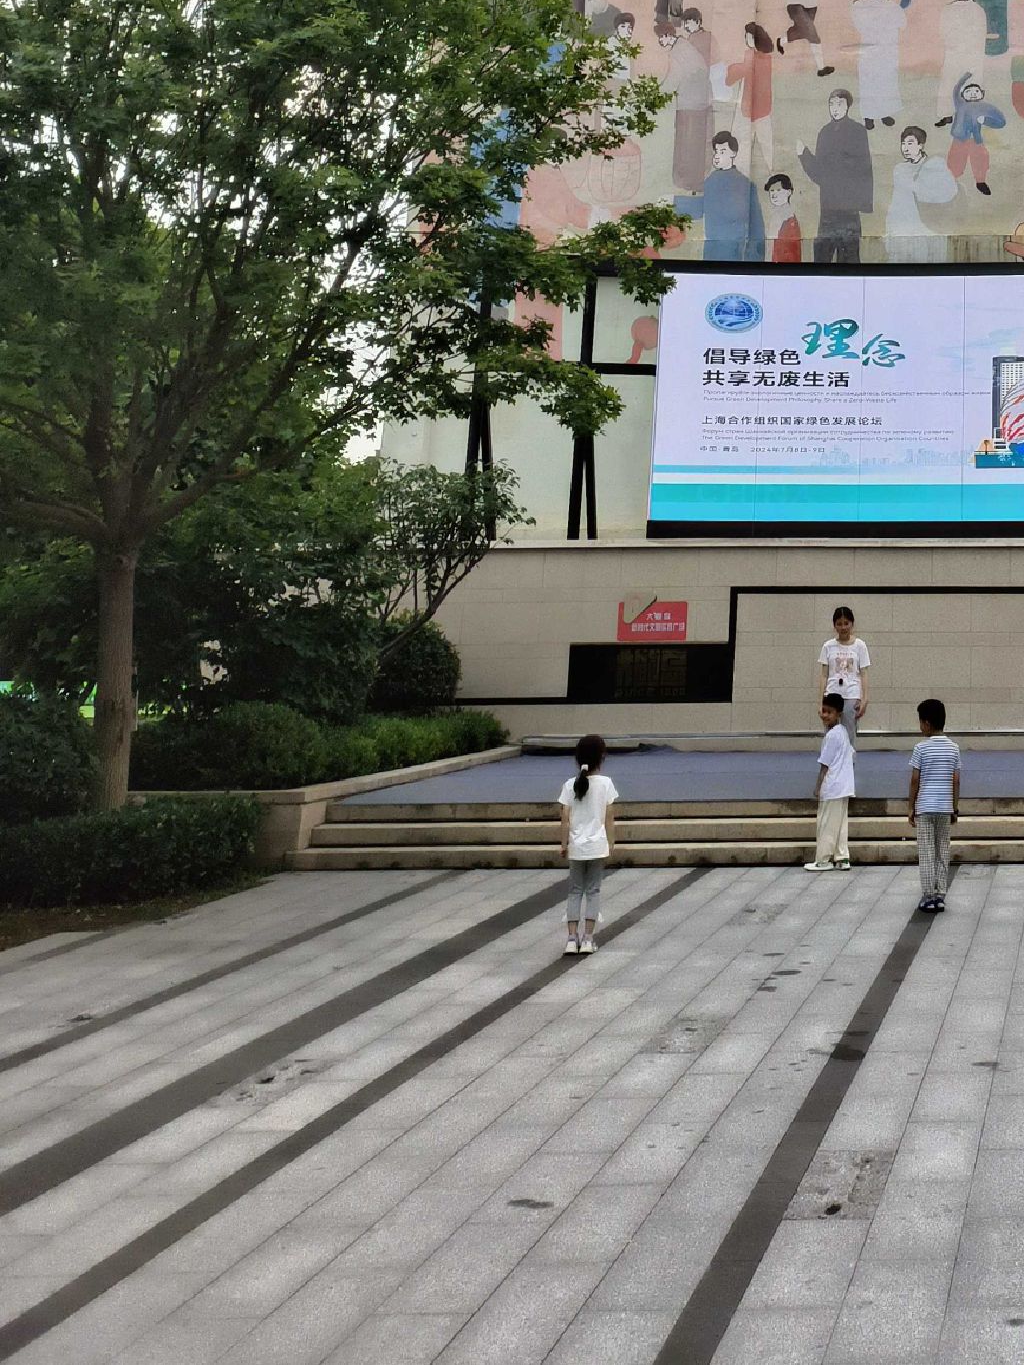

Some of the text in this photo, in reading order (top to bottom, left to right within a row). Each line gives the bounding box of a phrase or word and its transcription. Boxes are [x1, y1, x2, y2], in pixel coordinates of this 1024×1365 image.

[703, 318, 906, 368] 倡导绿色 理念
[702, 370, 850, 388] 共享无废生活
[702, 416, 882, 426] 上海合作组织国家绿色发展论坛
